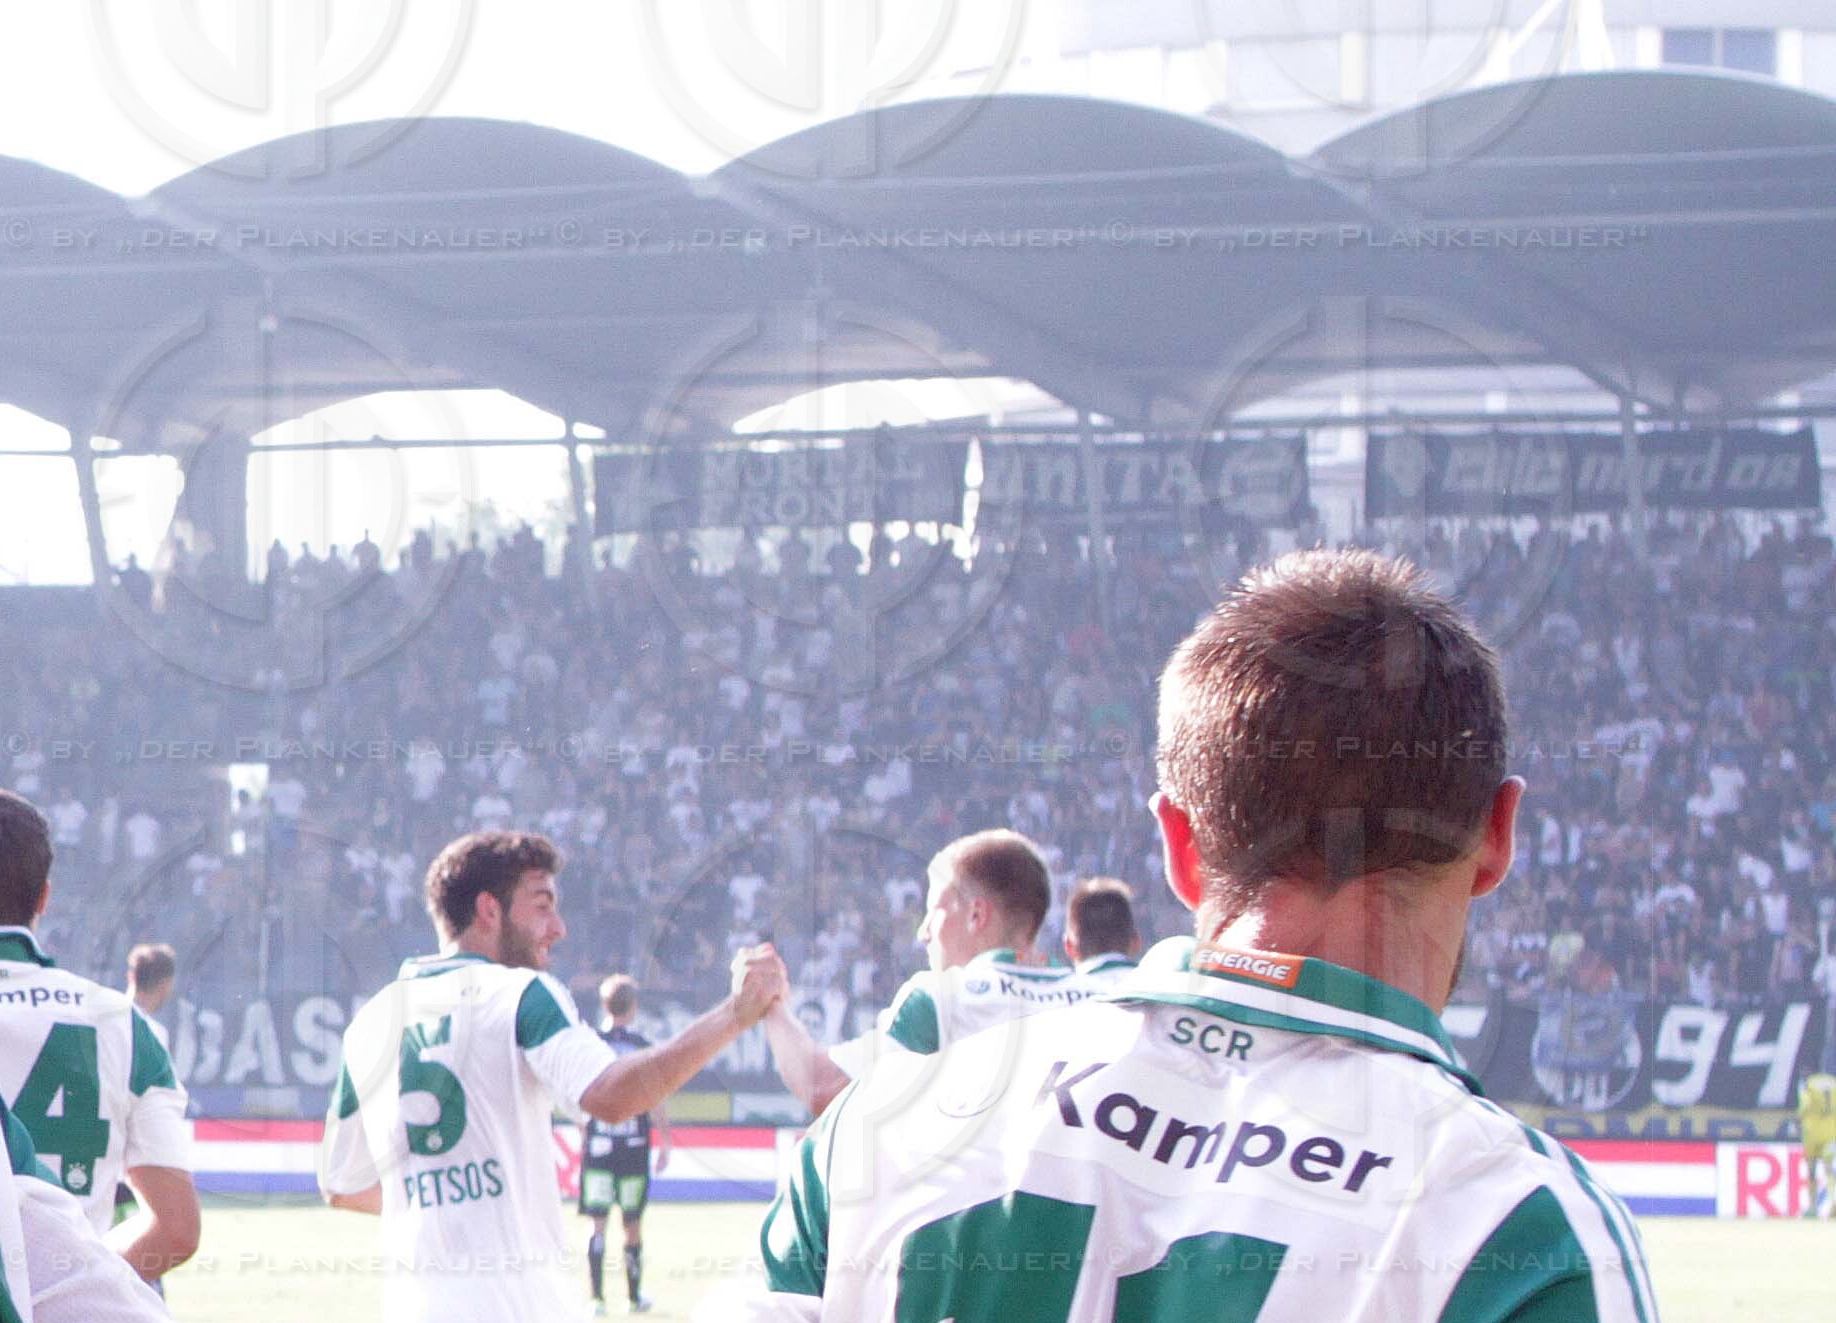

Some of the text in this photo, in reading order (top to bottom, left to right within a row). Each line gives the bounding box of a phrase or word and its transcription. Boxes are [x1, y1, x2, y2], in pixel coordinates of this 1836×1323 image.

[398, 1014, 468, 1157] 5
[1169, 1016, 1255, 1061] SCR
[1651, 1003, 1813, 1107] 94
[11, 1021, 111, 1197] 4
[1034, 1060, 1394, 1193] Kamper
